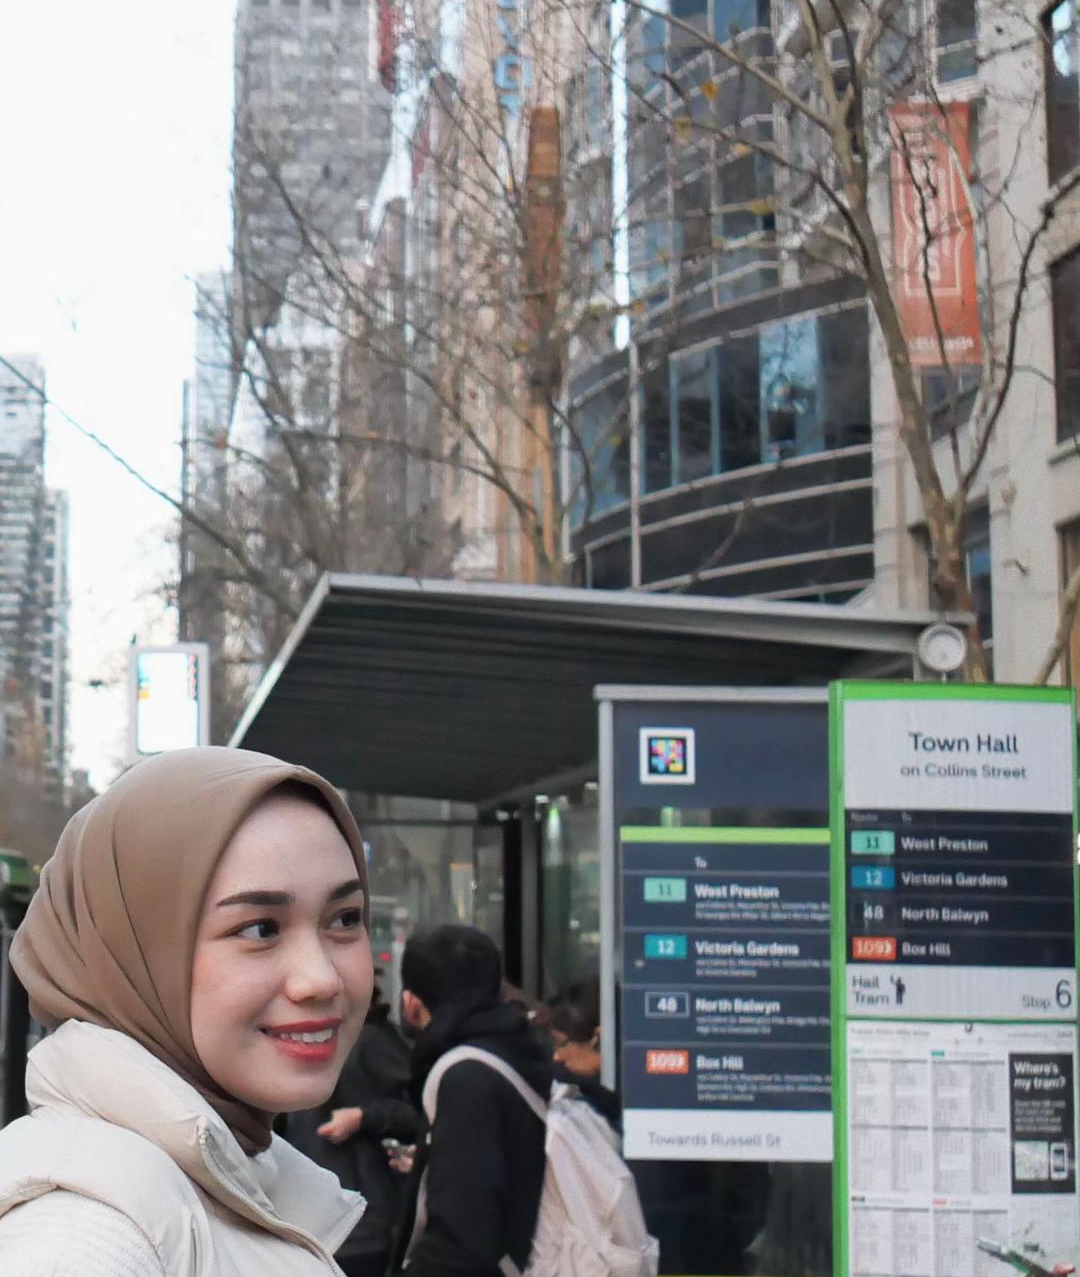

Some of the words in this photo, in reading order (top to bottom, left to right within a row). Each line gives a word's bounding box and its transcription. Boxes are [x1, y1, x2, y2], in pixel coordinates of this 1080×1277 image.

[908, 732, 969, 752] Town
[977, 734, 1019, 754] Hall
[900, 766, 920, 777] on
[925, 763, 978, 778] Collins
[982, 764, 1027, 779] Street
[866, 837, 879, 849] 11
[901, 837, 935, 851] West
[938, 838, 988, 852] Preston
[694, 856, 708, 869] To
[866, 871, 882, 885] 12
[901, 872, 952, 886] Victoria
[956, 873, 1008, 888] Gardens
[659, 884, 672, 896] 11
[694, 884, 727, 898] West
[730, 884, 779, 898] Preston
[864, 906, 884, 921] 48
[901, 907, 939, 921] North
[942, 908, 989, 925] Balwyn
[657, 940, 675, 955] 12
[695, 941, 744, 956] Victoria
[747, 941, 800, 956] Gardens
[902, 943, 926, 956] Box
[930, 943, 951, 957] Hill
[852, 975, 879, 989] Hail
[854, 991, 889, 1004] Tram
[1022, 995, 1052, 1010] Stop
[1055, 979, 1072, 1009] 6
[657, 997, 678, 1012] 48
[696, 998, 731, 1013] North
[734, 999, 780, 1015] Balwyn
[696, 1055, 720, 1070] Box
[722, 1055, 744, 1070] Hill
[1014, 1062, 1059, 1075] Where's
[1014, 1079, 1032, 1092] my
[1033, 1076, 1066, 1090] tram?
[648, 1132, 707, 1147] Towards
[711, 1132, 762, 1148] Russell
[766, 1133, 781, 1148] St
